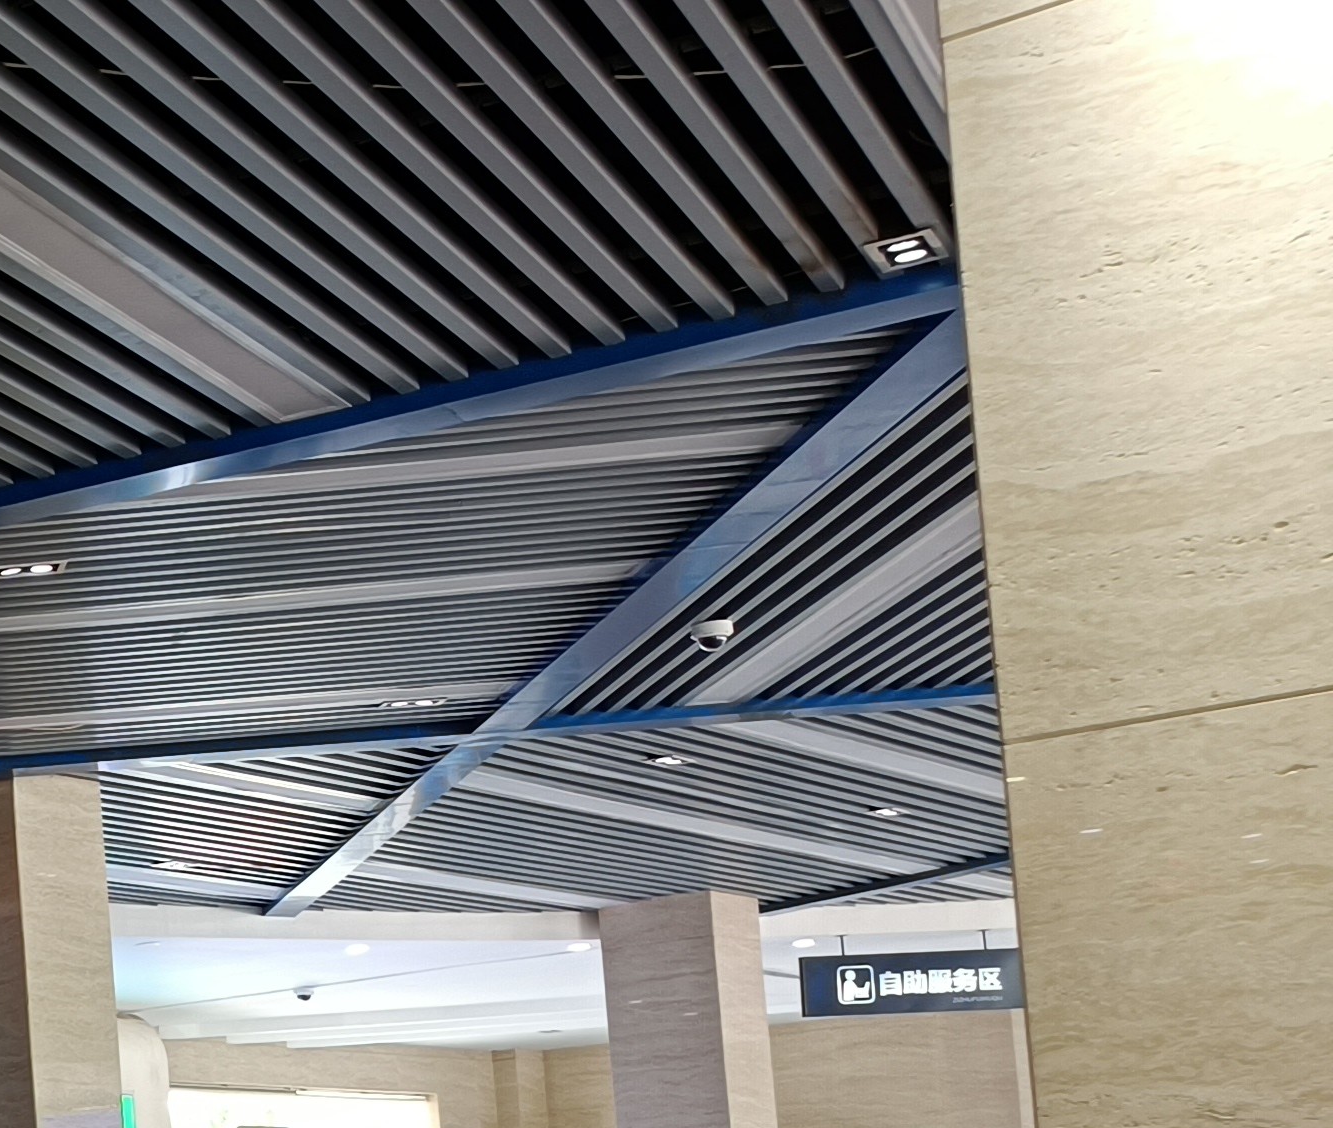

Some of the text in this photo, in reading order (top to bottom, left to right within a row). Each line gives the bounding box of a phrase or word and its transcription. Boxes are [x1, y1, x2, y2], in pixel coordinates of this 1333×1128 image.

[879, 967, 1003, 996] 自助服务区
